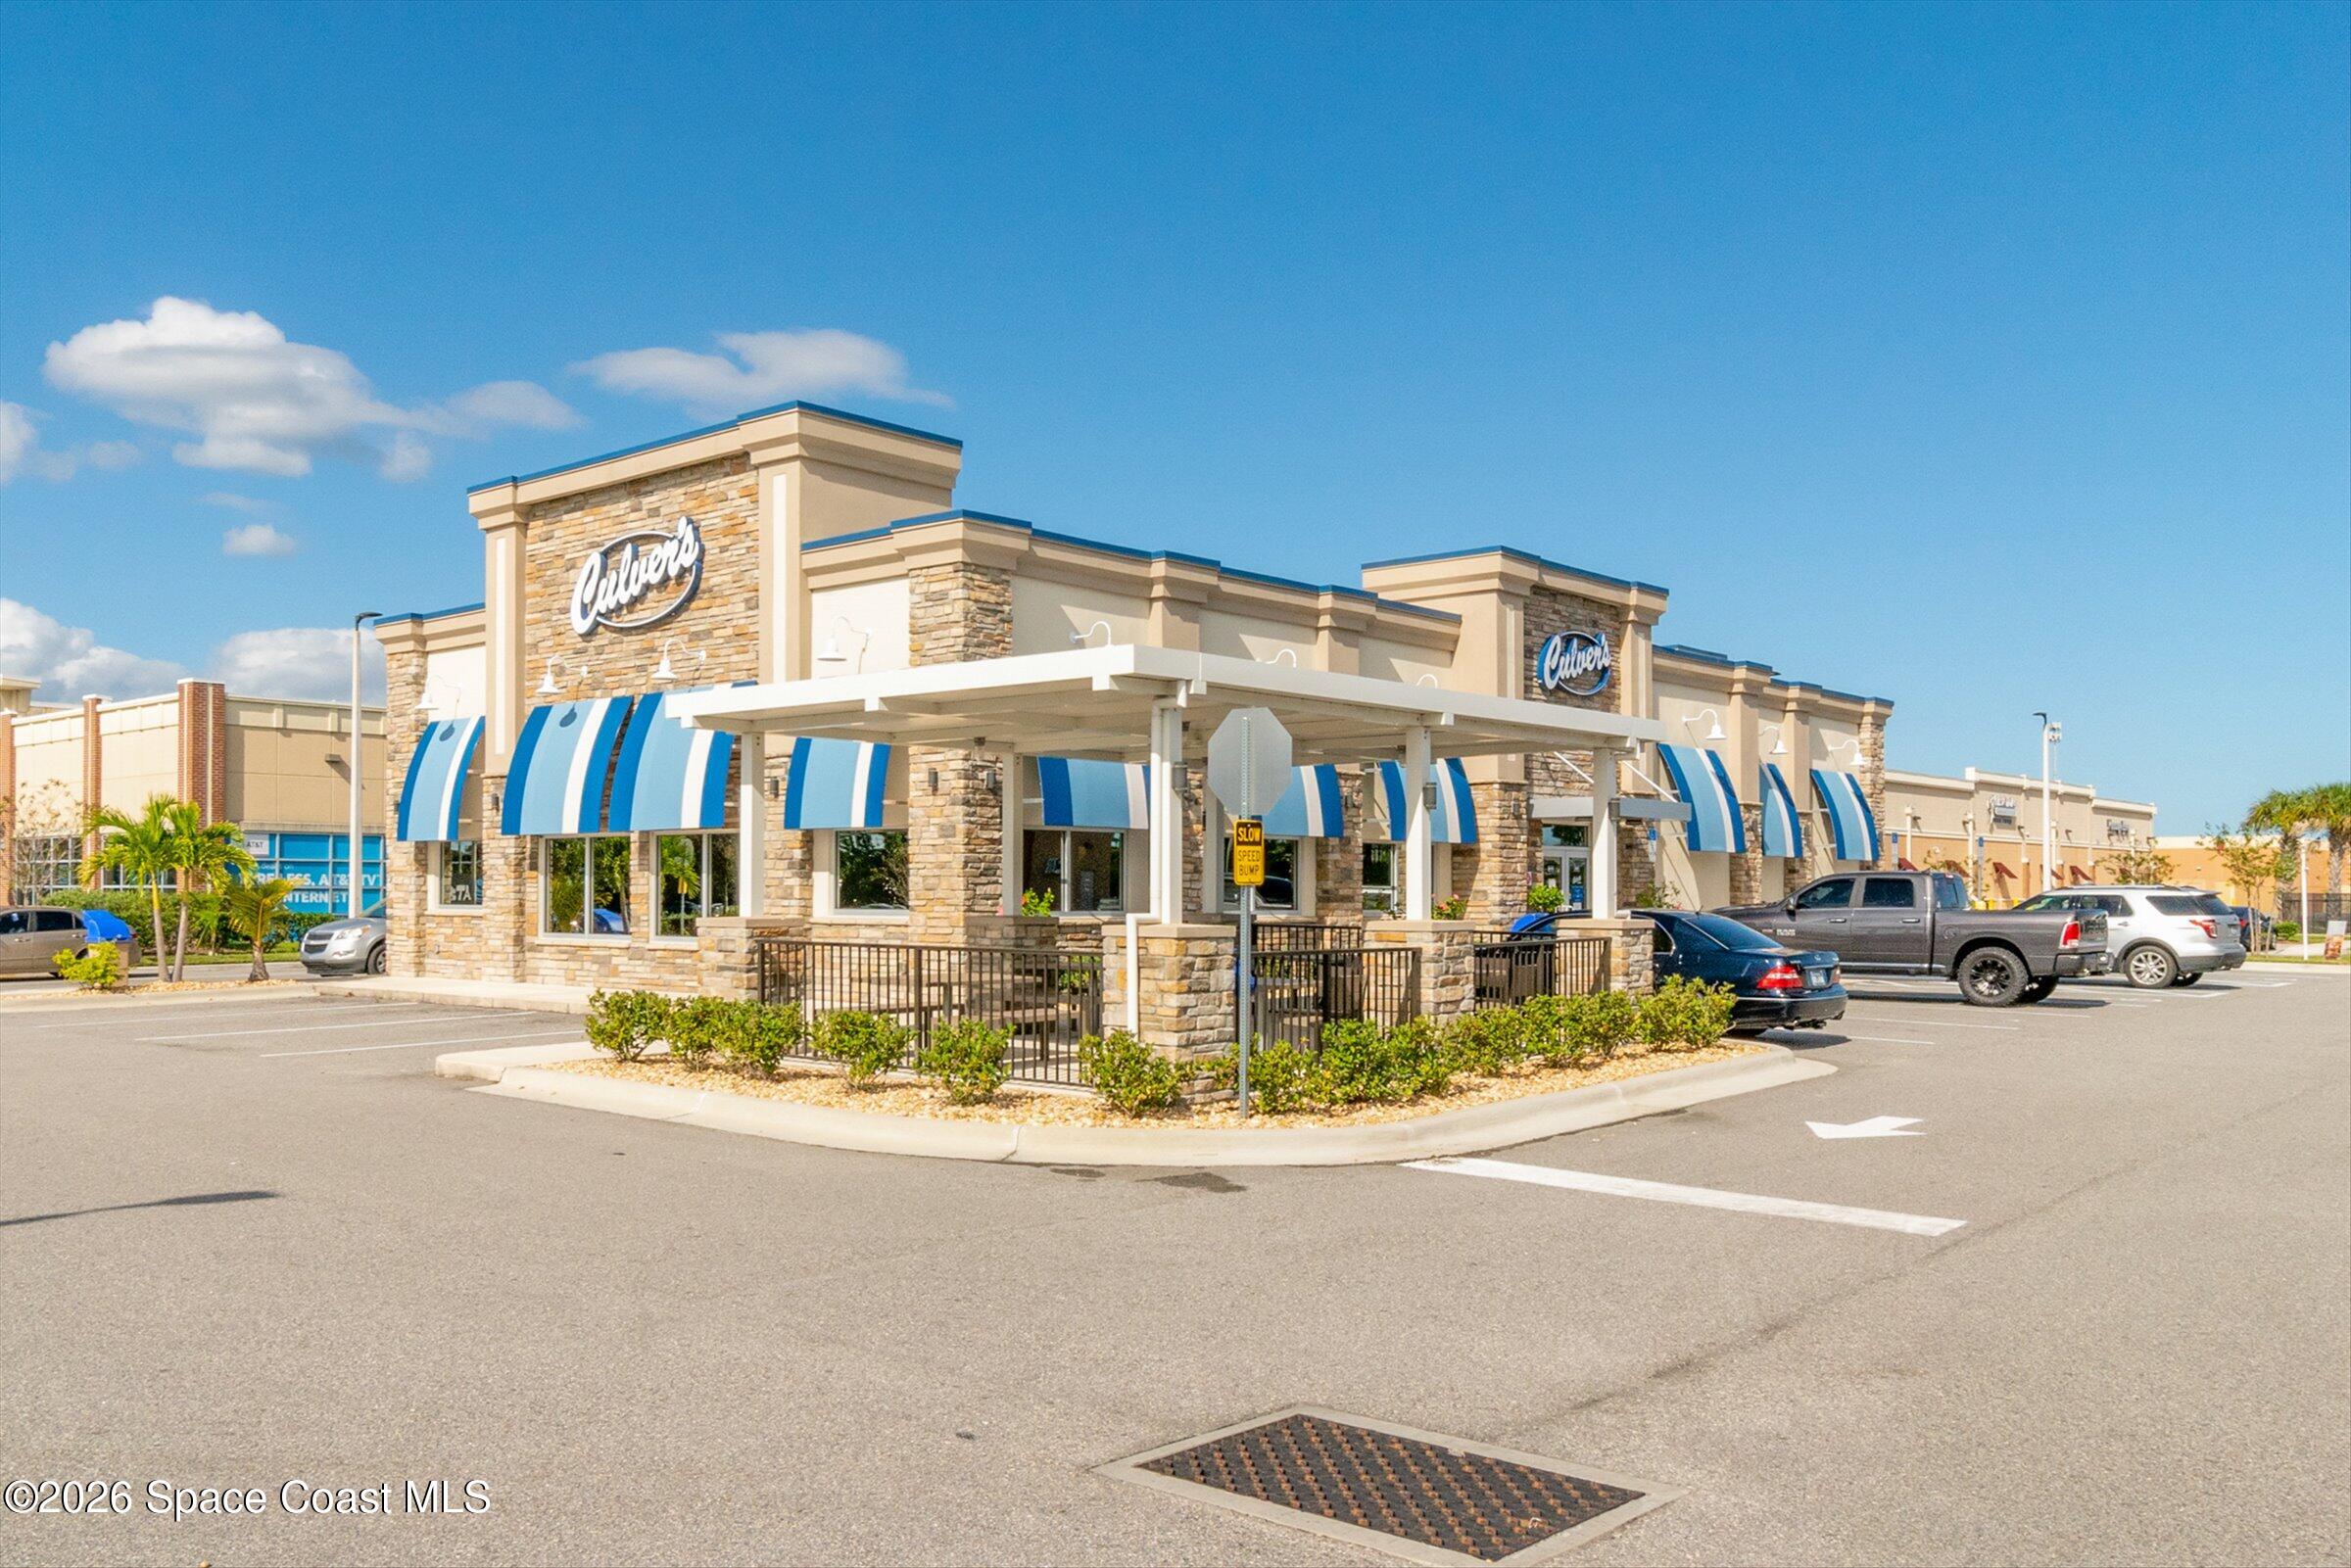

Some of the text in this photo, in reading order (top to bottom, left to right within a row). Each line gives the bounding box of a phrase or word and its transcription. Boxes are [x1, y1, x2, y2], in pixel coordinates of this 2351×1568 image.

[570, 515, 700, 635] Culver's
[1542, 632, 1611, 689] Culver's
[1238, 828, 1261, 841] SLOW
[1238, 850, 1260, 862] SPEED
[1239, 865, 1260, 876] BUMP
[282, 891, 349, 903] NTERNET
